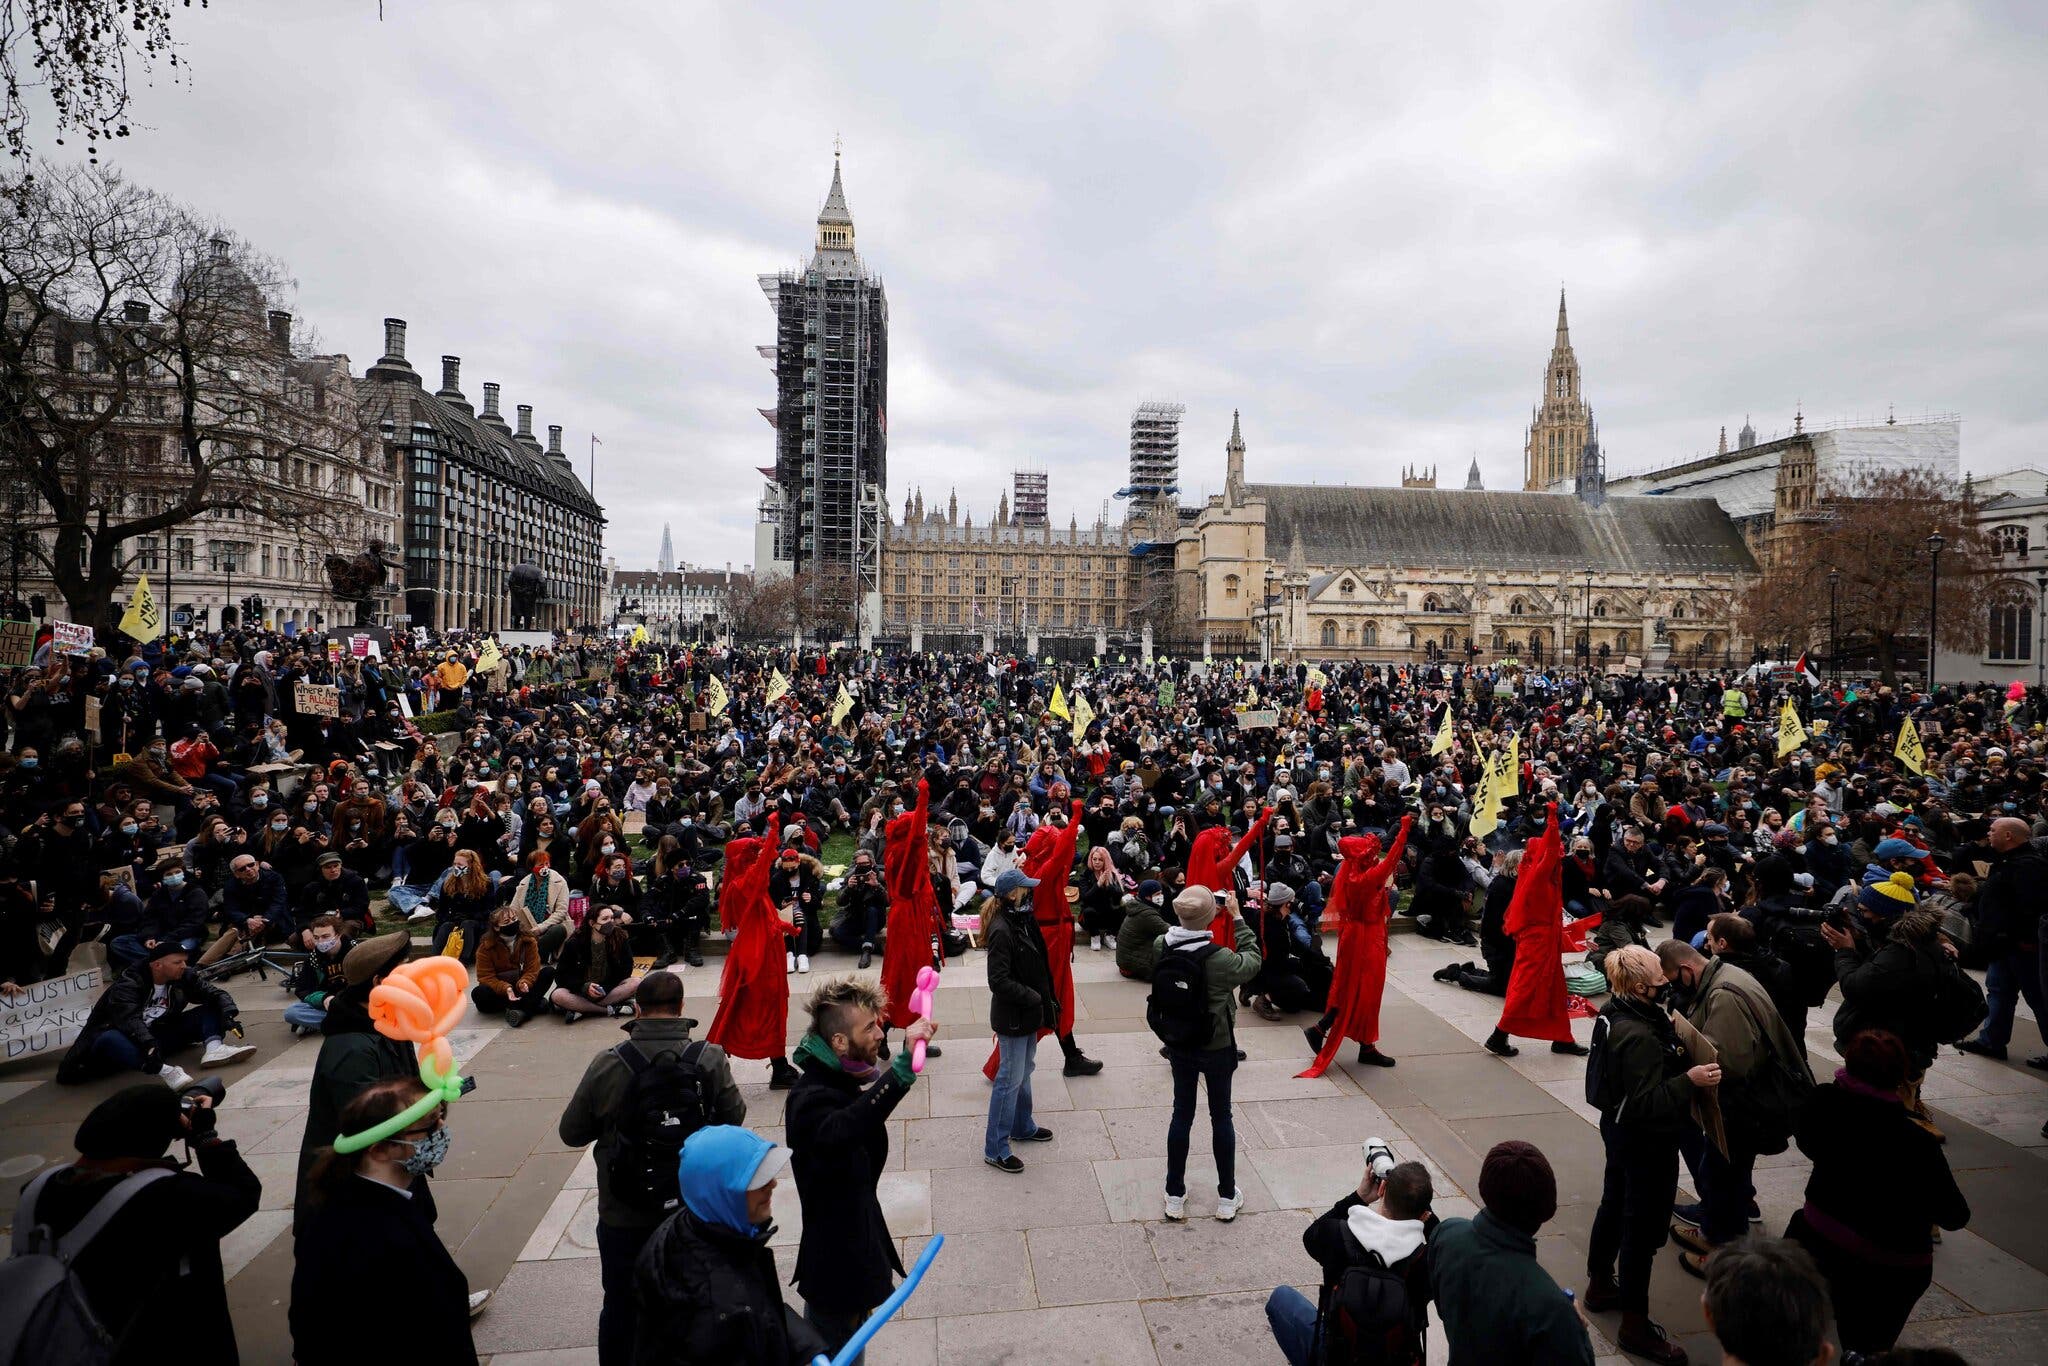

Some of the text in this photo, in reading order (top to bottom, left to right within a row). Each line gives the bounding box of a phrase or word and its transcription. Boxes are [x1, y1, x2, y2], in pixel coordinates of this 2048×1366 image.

[176, 613, 184, 622] P
[1, 620, 33, 637] KILL
[0, 635, 32, 652] THE
[296, 685, 338, 698] Where Am
[298, 695, 306, 703] I
[299, 702, 312, 713] To
[7, 1024, 84, 1057] DUT
